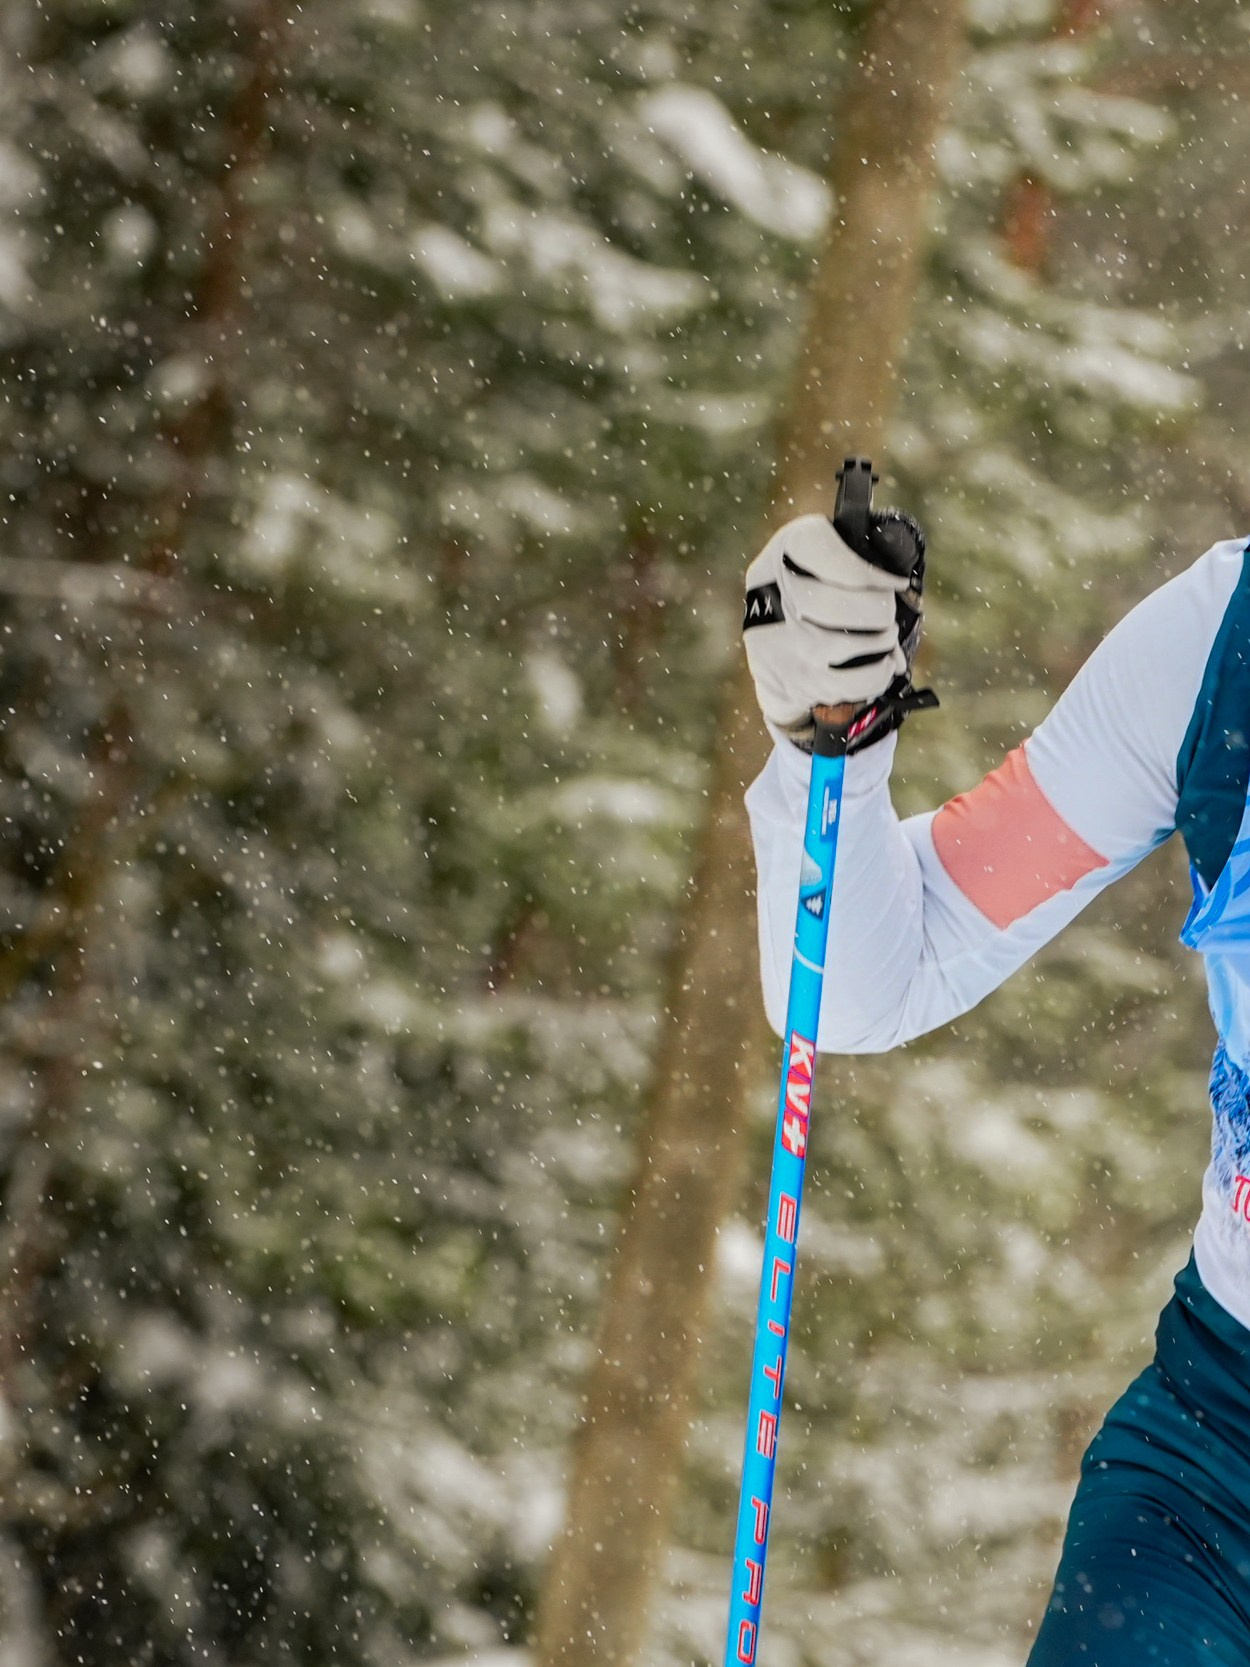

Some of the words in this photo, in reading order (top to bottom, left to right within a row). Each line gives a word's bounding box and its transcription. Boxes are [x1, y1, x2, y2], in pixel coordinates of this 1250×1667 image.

[744, 594, 774, 619] AX
[755, 1189, 798, 1461] ELITE
[735, 1494, 770, 1665] PRO
